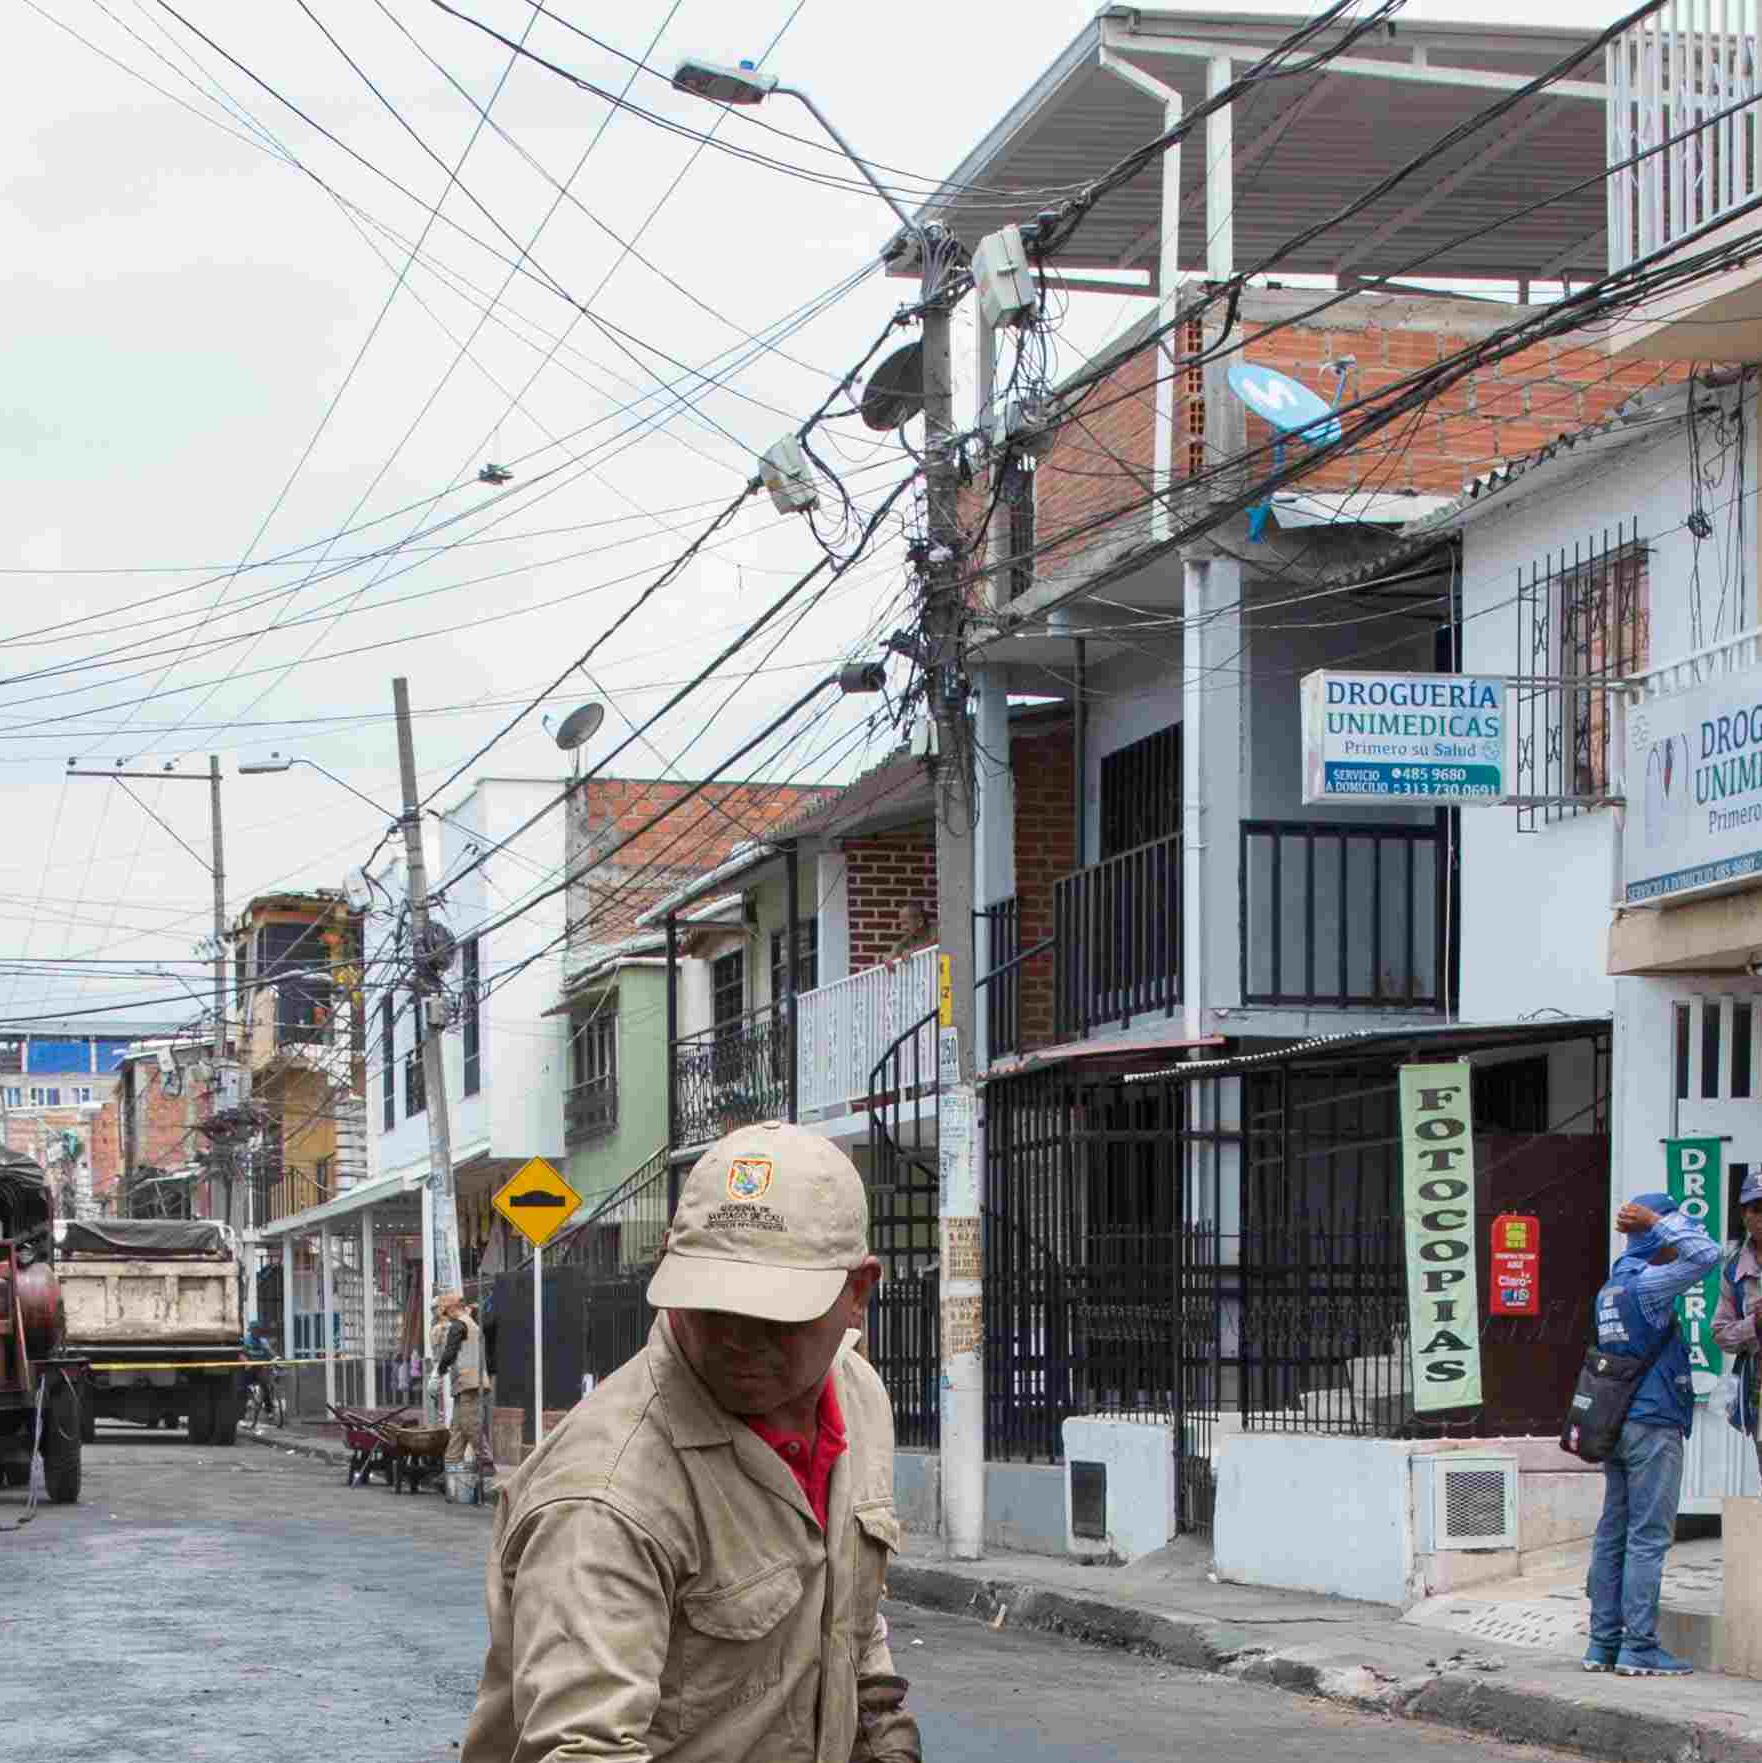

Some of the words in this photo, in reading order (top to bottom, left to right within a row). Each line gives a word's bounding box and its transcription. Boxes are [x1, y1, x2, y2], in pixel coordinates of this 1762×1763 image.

[1326, 680, 1499, 709] DROGUERÍA
[1326, 712, 1500, 738] UNIMEDICAS
[1344, 739, 1407, 756] Primero
[1412, 744, 1429, 757] su
[1436, 742, 1477, 758] Salud
[1332, 768, 1381, 782] SERVICIO
[1402, 768, 1429, 781] 485
[1431, 768, 1467, 782] 9680
[1325, 782, 1333, 792] A
[1337, 782, 1388, 794] DOMICILIO
[1403, 783, 1429, 796] 313
[1709, 802, 1762, 834] Primero
[1414, 1085, 1475, 1384] FOTOCOPIAS
